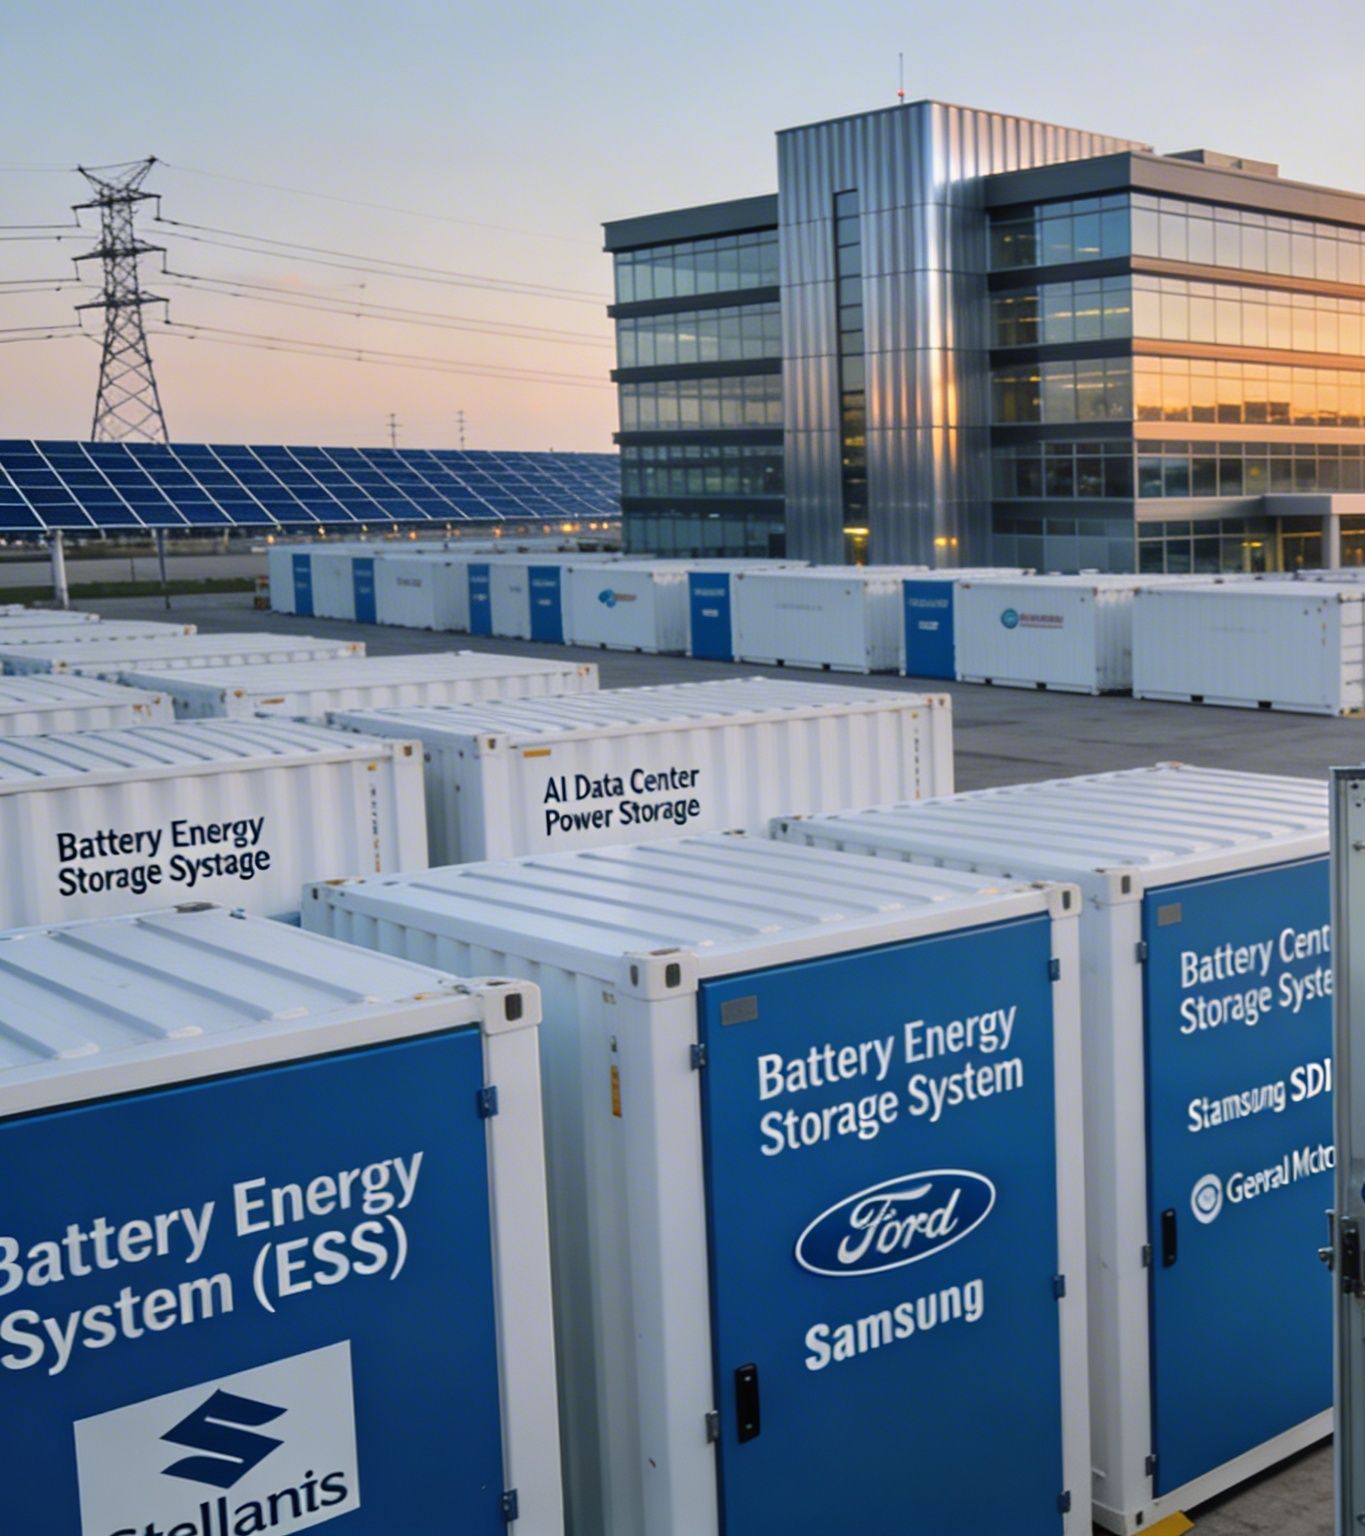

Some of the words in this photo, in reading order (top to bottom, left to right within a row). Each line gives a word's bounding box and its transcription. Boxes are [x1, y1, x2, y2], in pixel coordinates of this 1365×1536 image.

[543, 776, 567, 804] AI
[575, 773, 625, 801] Data
[630, 766, 700, 794] Center
[56, 828, 162, 862] Battery
[170, 816, 265, 849] Energy
[545, 808, 613, 836] Power
[619, 798, 701, 826] Storage
[58, 862, 162, 897] Storage
[169, 849, 271, 887] Systage
[1180, 938, 1273, 989] Battery
[1180, 985, 1272, 1035] Storage
[757, 1035, 894, 1100] Battery
[904, 1005, 1017, 1064] Energy
[1290, 1057, 1333, 1103] SDI
[760, 1089, 899, 1157] Storage
[908, 1056, 1024, 1122] System
[0, 1201, 216, 1297] Battery
[233, 1151, 425, 1238] Energy
[837, 1183, 962, 1265] Ford
[0, 1272, 234, 1377] System
[253, 1215, 409, 1314] (ESS)
[805, 1279, 985, 1371] Samsung
